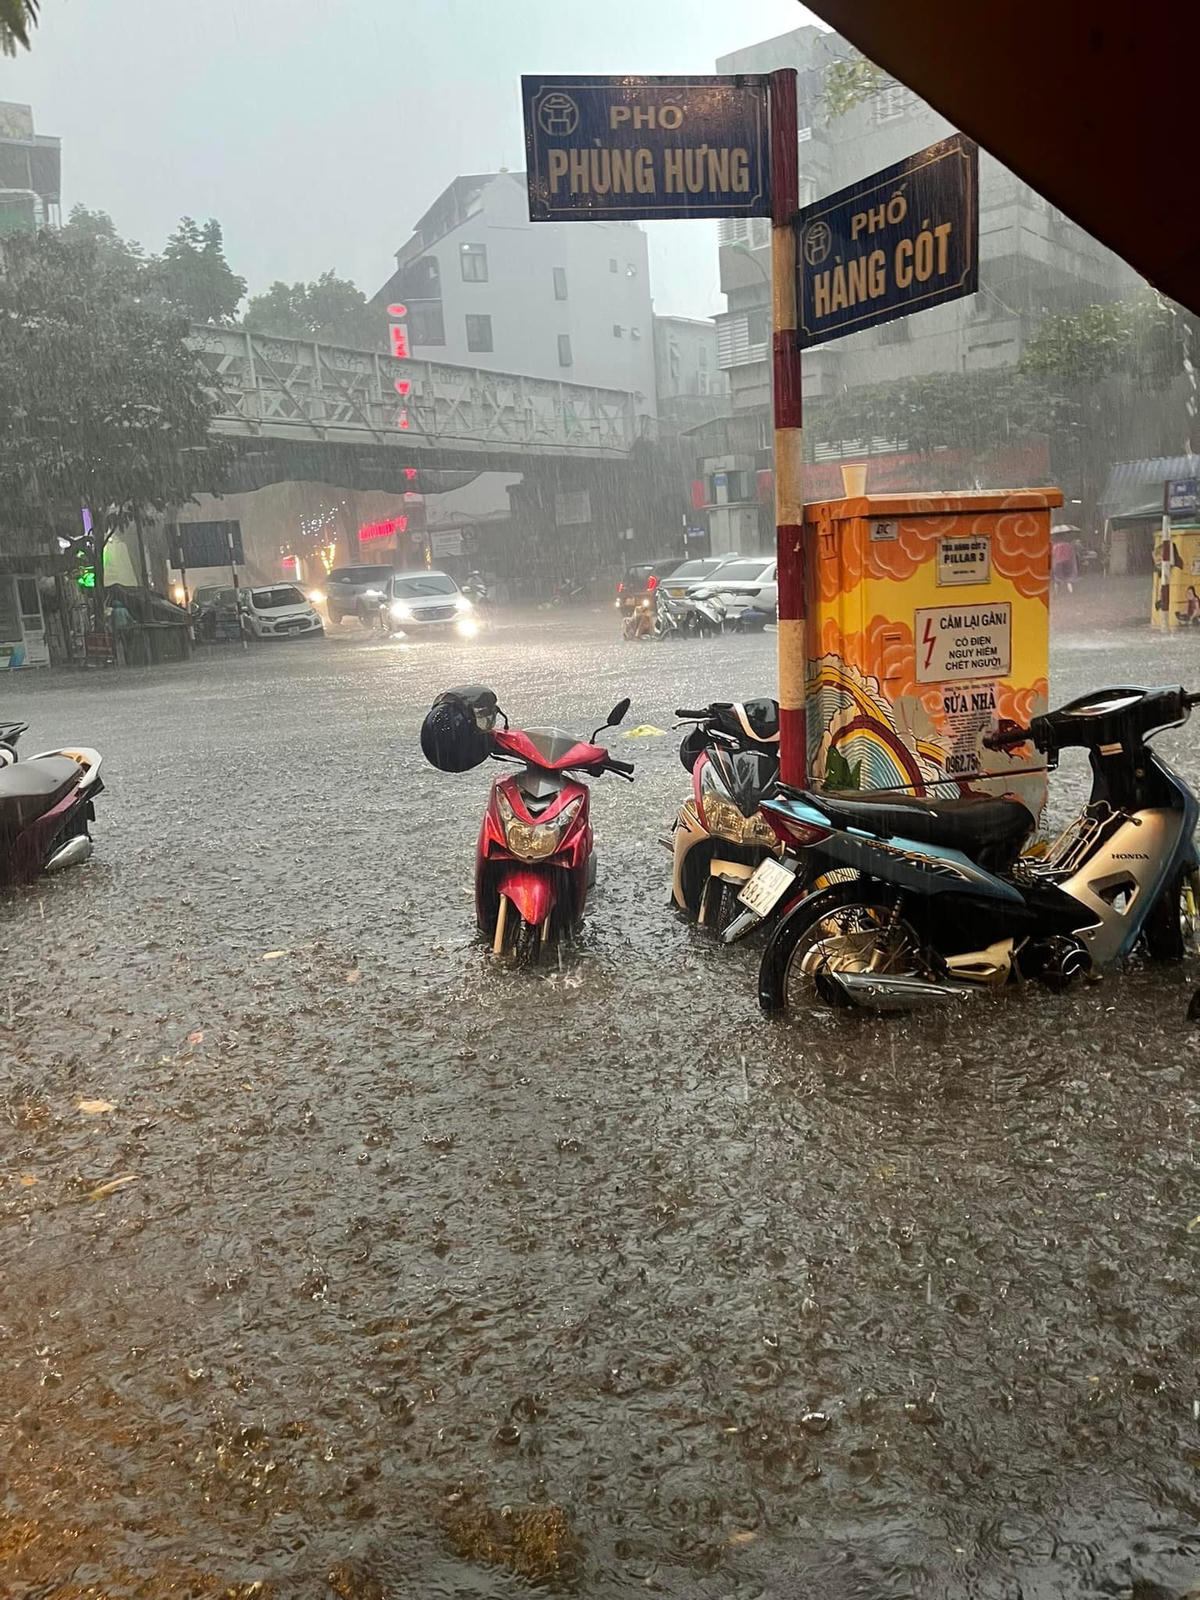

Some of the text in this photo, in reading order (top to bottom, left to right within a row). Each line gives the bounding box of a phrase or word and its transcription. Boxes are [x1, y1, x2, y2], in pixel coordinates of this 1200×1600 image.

[610, 94, 684, 130] PHỐ
[549, 138, 750, 195] PHÙNG HƯNG
[851, 183, 908, 240] PHỐ
[814, 218, 952, 318] HÀNG CÓT
[944, 552, 985, 563] PILLAR 3
[964, 614, 979, 630] LẠI
[949, 649, 974, 659] NGUY
[943, 688, 996, 714] SỬA NHÀ
